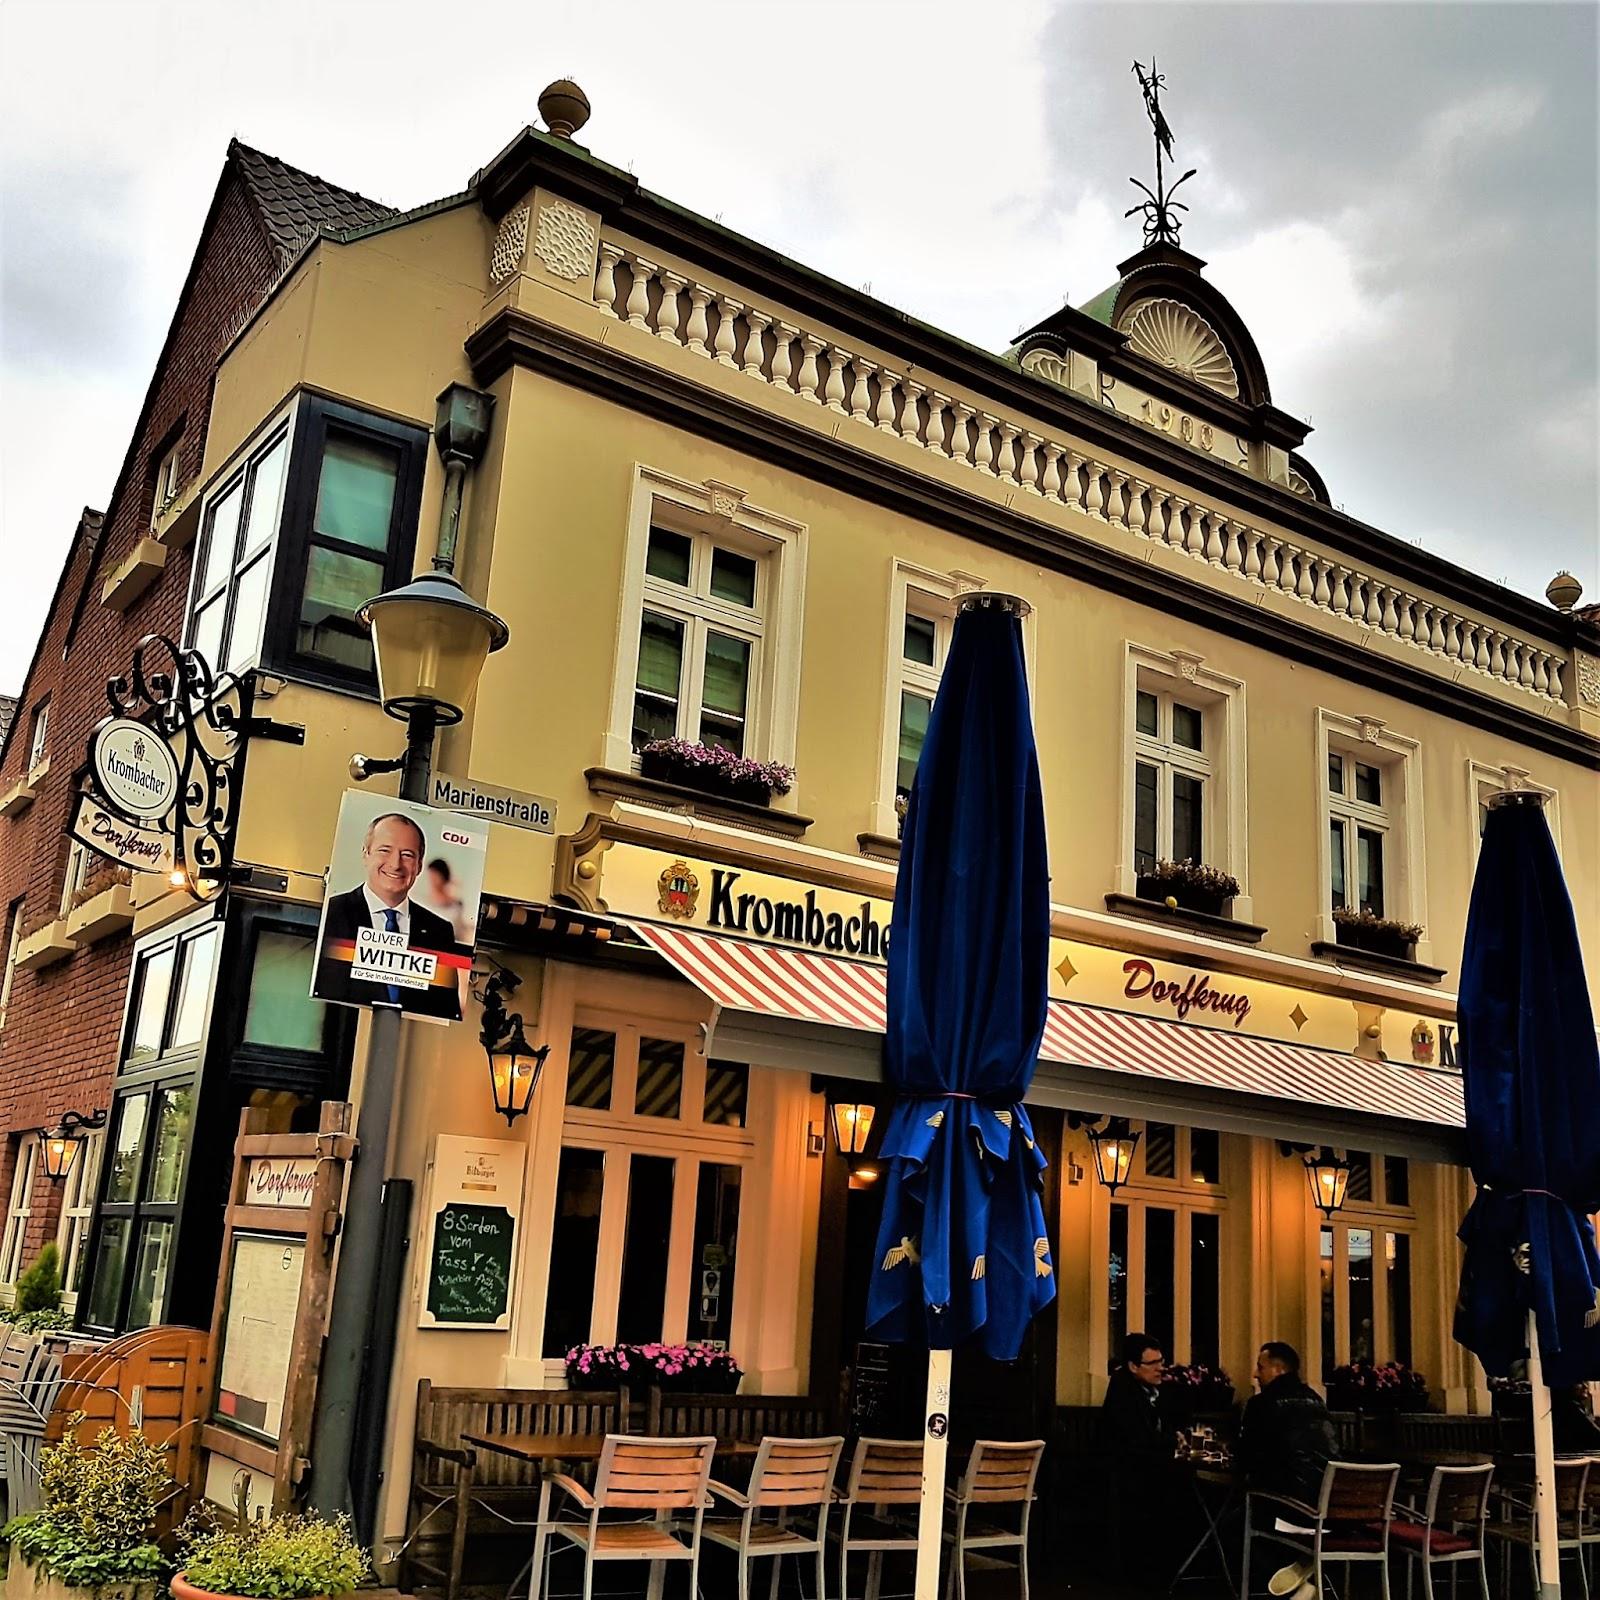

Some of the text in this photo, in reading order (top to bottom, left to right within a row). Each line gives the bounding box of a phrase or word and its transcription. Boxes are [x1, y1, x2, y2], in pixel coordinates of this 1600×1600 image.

[1142, 399, 1213, 451] 1900
[107, 748, 165, 796] Krombacher
[435, 780, 549, 825] Marienstraße
[91, 812, 162, 864] Dorfkrug
[442, 832, 469, 845] CDU
[706, 868, 891, 961] Krombache
[359, 946, 433, 975] WITTKE
[361, 930, 404, 947] OLIVER
[1123, 959, 1252, 1028] Dorfkrug
[256, 1160, 314, 1204] Dorfkrug
[443, 1210, 500, 1235] 8 Sorten
[450, 1235, 472, 1249] vom
